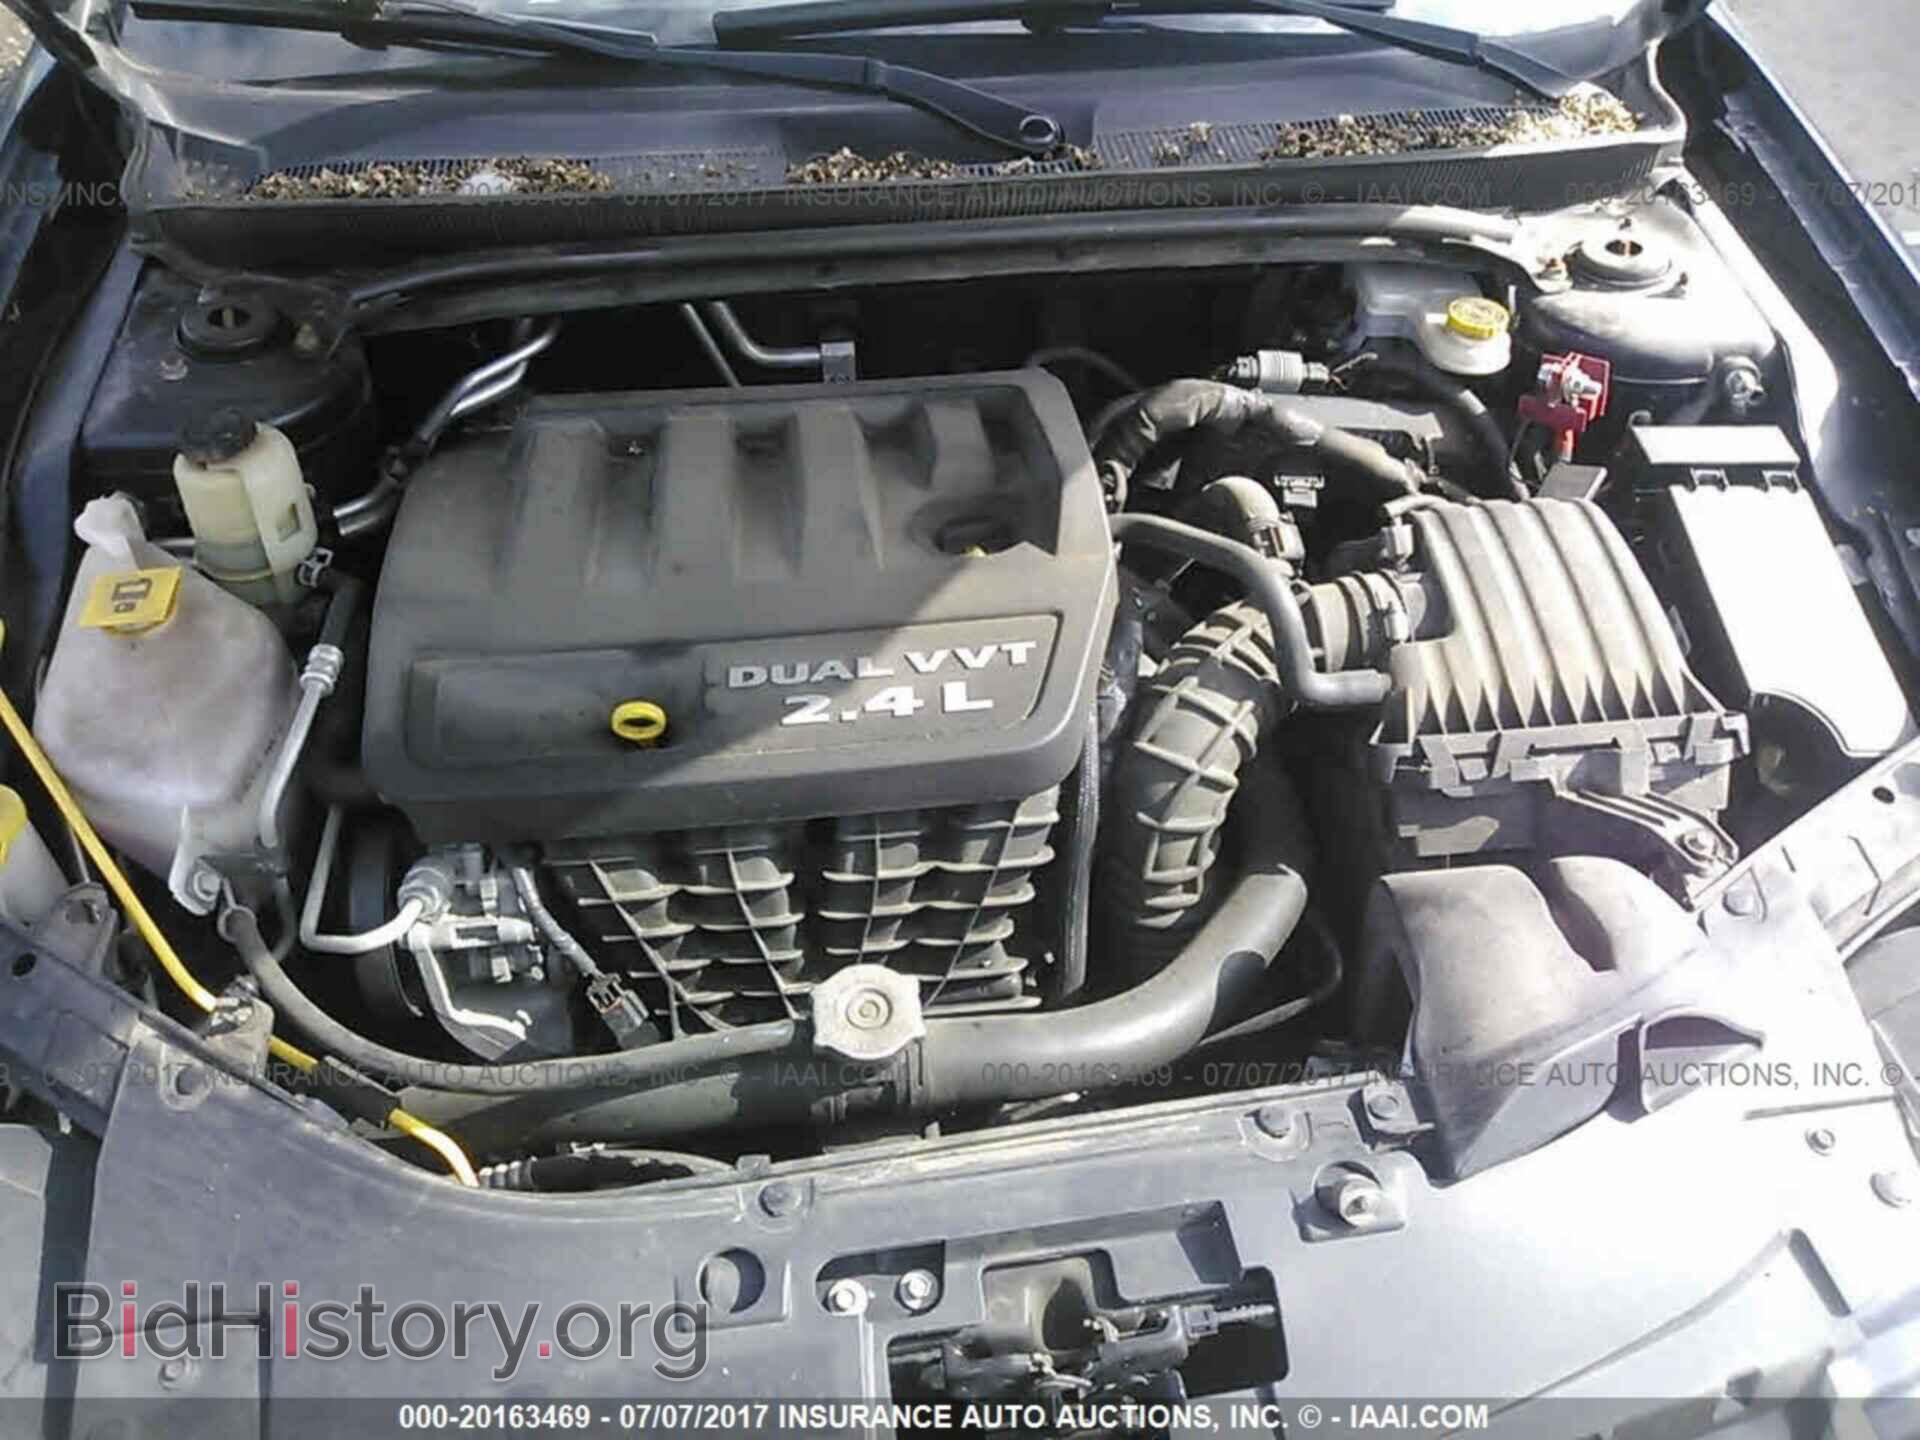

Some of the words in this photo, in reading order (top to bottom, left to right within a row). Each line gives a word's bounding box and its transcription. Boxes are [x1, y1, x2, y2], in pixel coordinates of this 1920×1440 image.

[727, 656, 895, 689] DUAL
[904, 640, 1037, 674] VVT
[779, 685, 926, 727] 2.4
[942, 680, 994, 714] L
